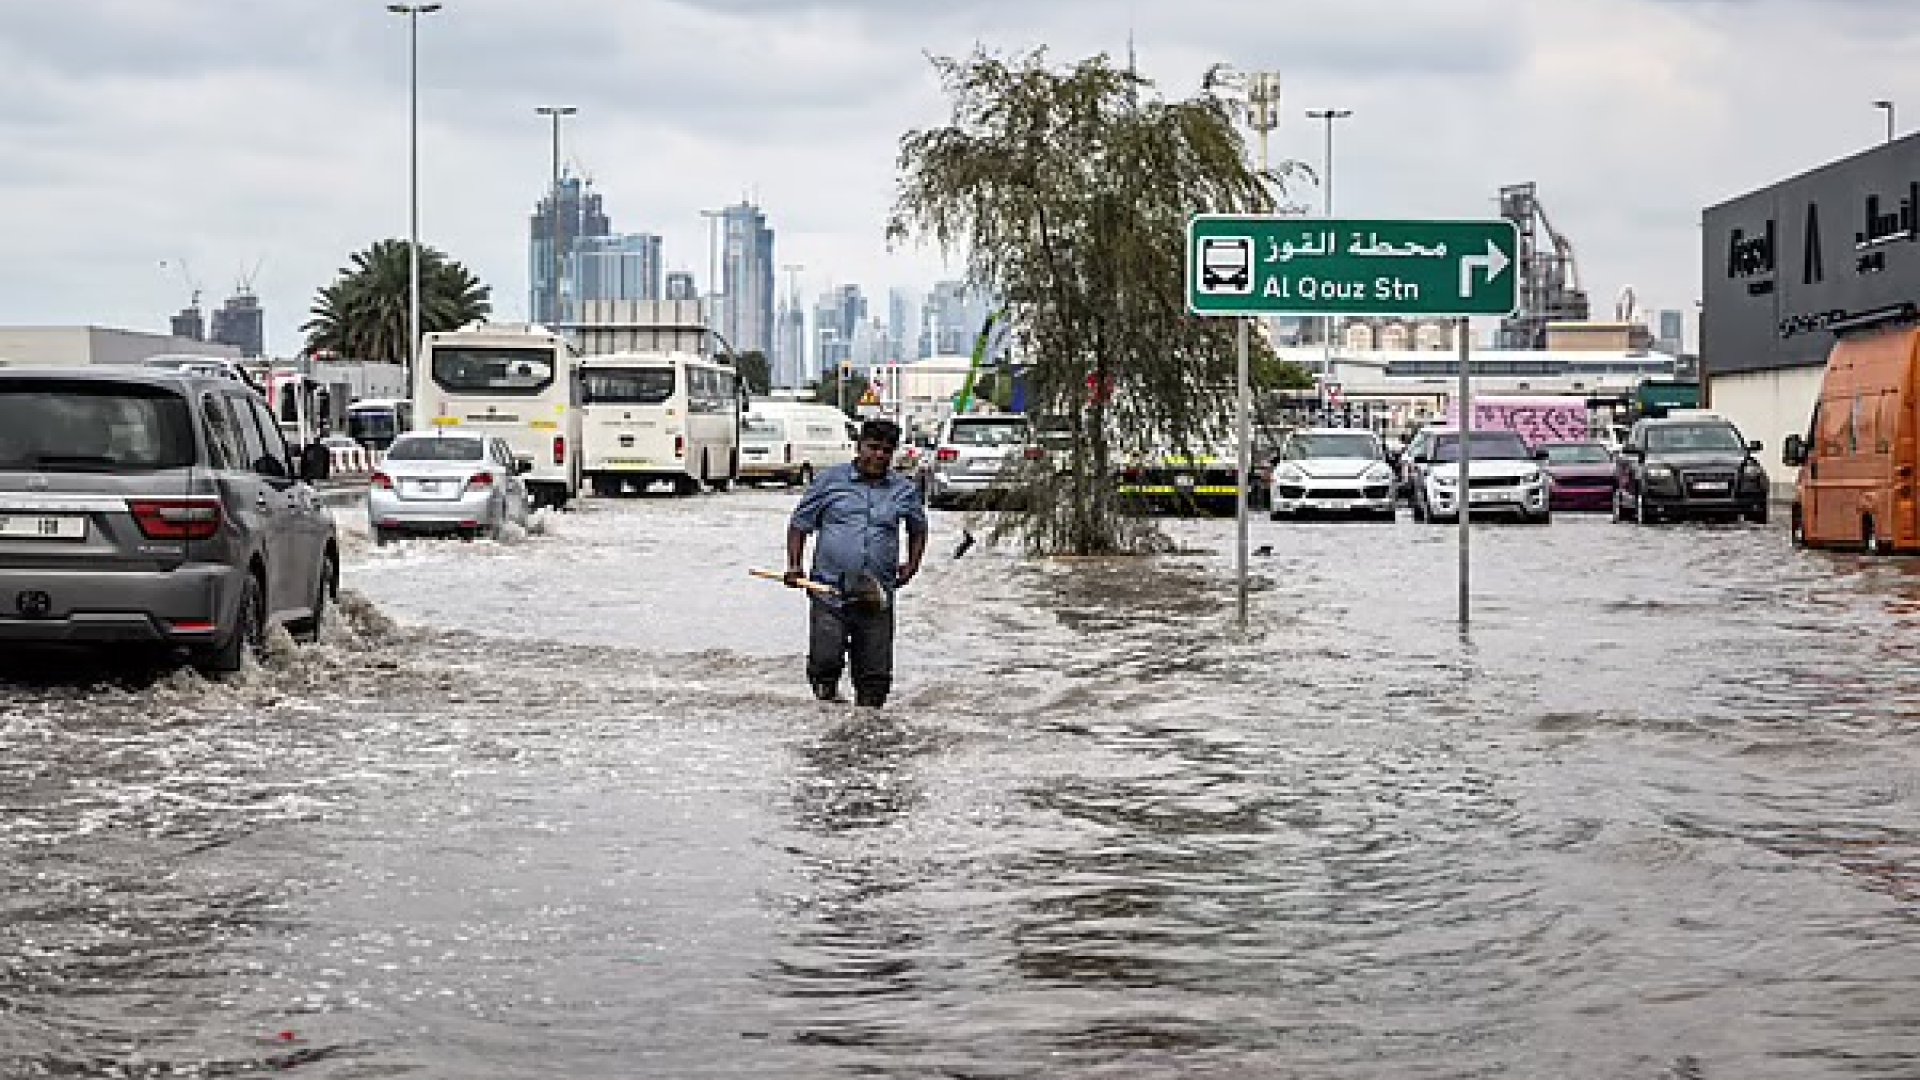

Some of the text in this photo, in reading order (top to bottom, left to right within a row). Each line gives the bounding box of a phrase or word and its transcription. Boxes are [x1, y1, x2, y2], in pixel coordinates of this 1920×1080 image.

[1263, 230, 1447, 262] محطة القوز
[1263, 275, 1419, 301] Al Qouz Stn
